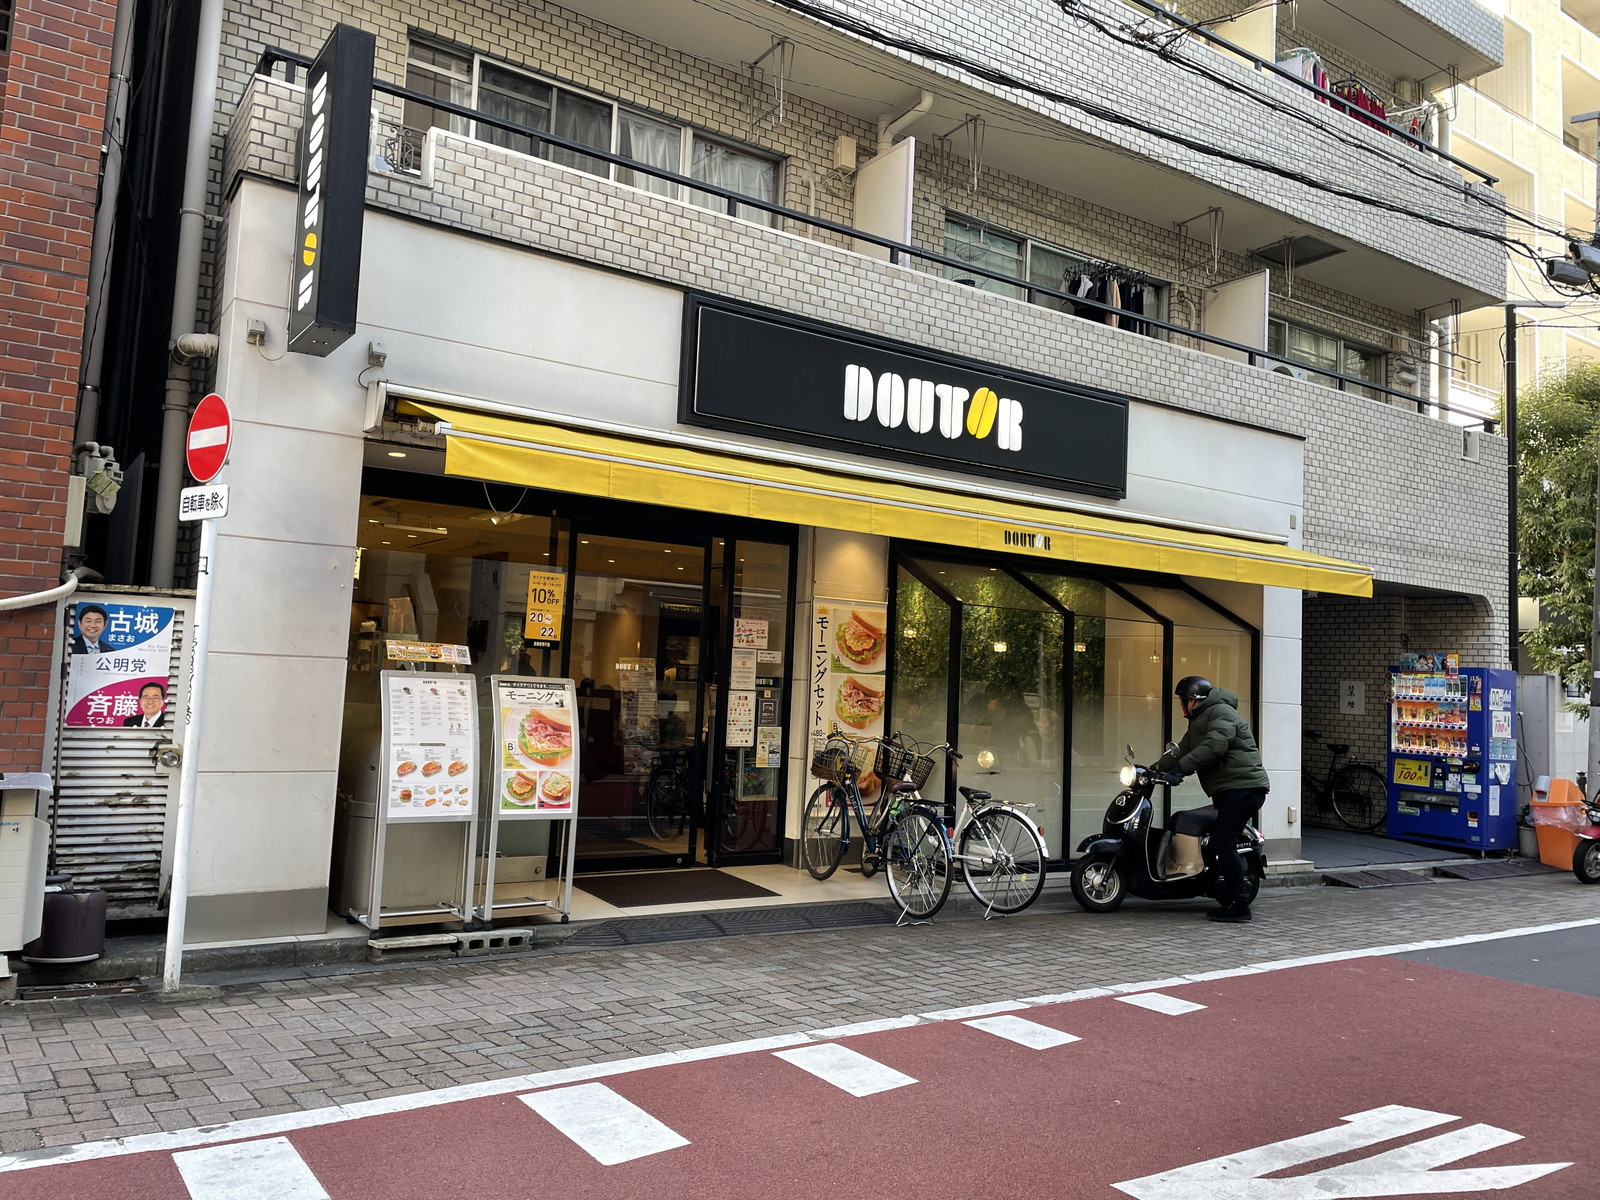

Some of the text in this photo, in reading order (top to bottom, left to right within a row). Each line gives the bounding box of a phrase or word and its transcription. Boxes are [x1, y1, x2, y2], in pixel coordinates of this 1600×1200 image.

[298, 71, 328, 311] DOUTOR
[843, 363, 1024, 452] DOUTOR
[182, 491, 225, 513] 自転車を除く
[1004, 529, 1051, 551] DOUTOR
[531, 588, 555, 603] 10%
[109, 611, 159, 634] 古城
[108, 634, 135, 643] まさお
[96, 657, 146, 673] 公明党
[814, 617, 829, 726] モーニングセット
[87, 693, 139, 717] 斉藤
[87, 716, 114, 725] てつお
[507, 742, 514, 751] B
